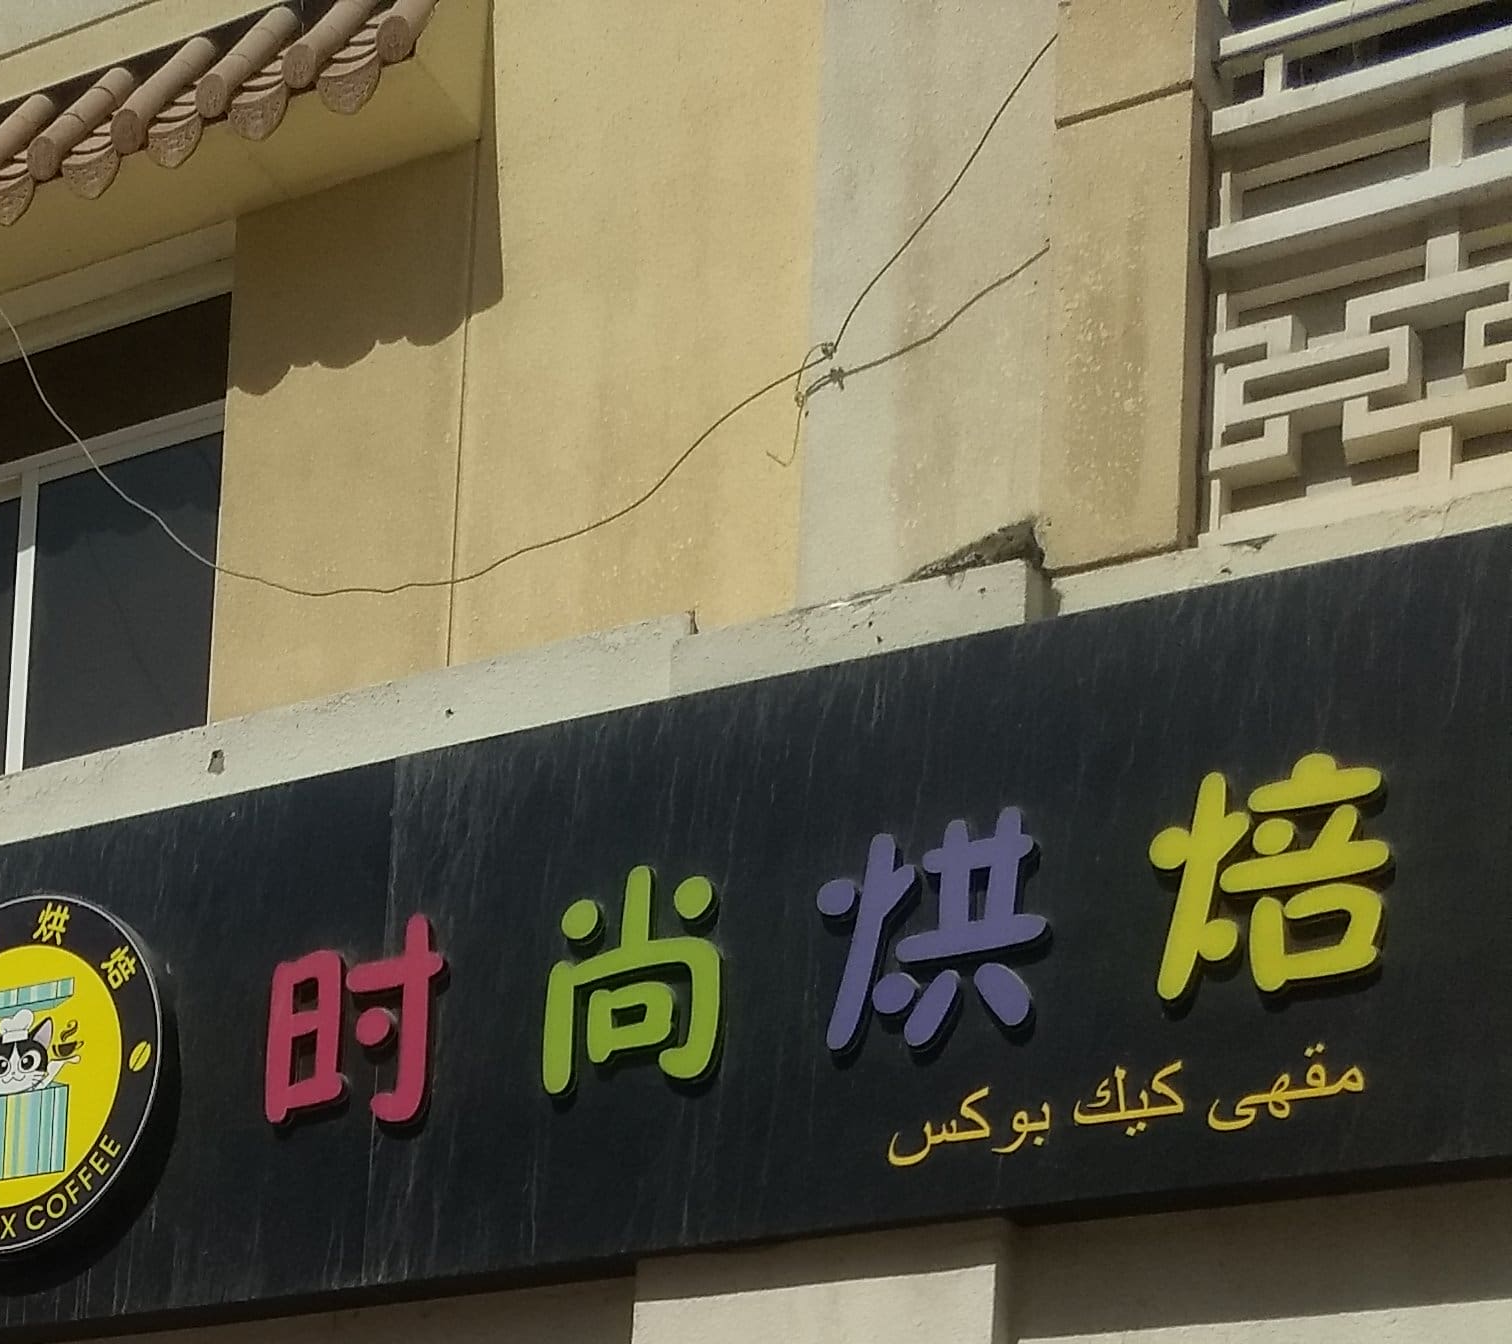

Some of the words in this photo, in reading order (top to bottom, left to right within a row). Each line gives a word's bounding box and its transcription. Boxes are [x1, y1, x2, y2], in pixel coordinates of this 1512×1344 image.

[265, 752, 1392, 1124] 时尚烘焙
[888, 1087, 1051, 1167] بوكس
[1073, 1060, 1185, 1136] كيك
[1207, 1041, 1365, 1131] مقهى
[24, 1134, 122, 1231] COFFEE
